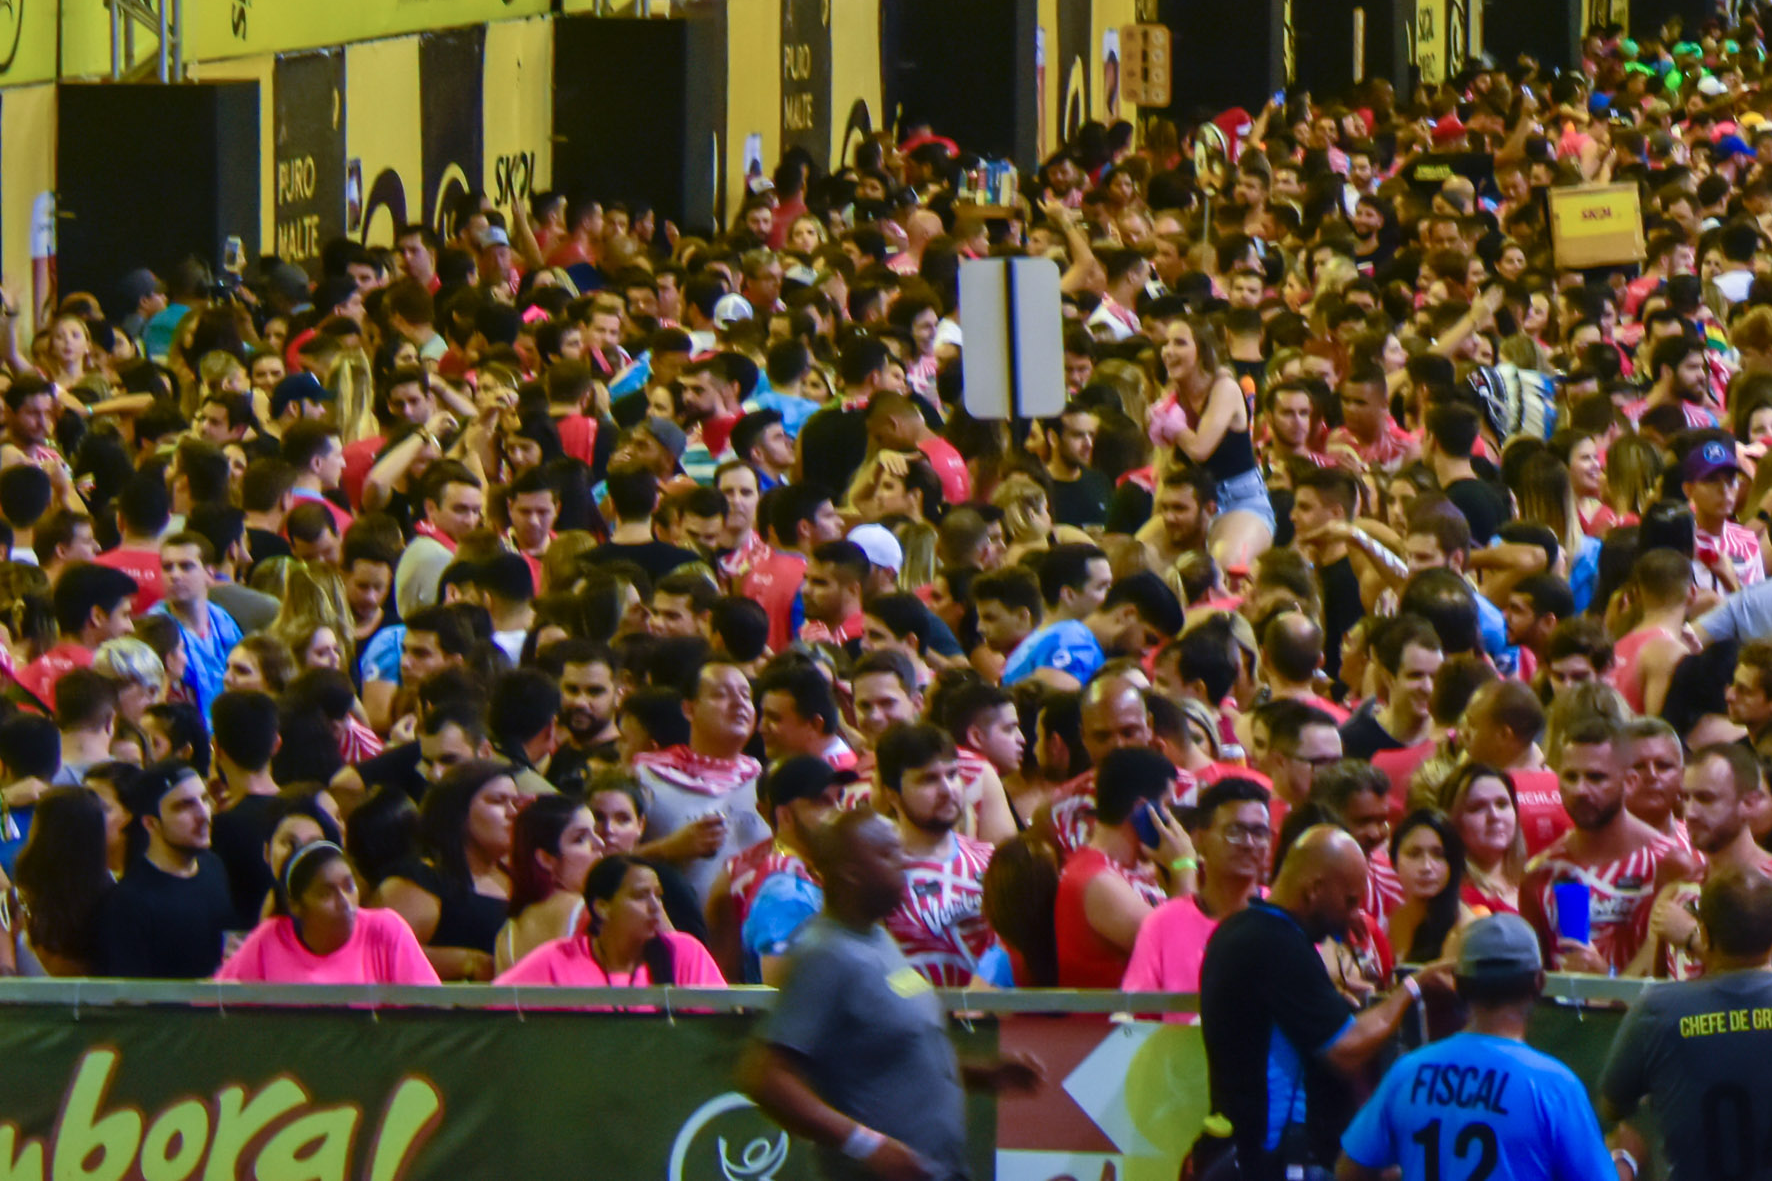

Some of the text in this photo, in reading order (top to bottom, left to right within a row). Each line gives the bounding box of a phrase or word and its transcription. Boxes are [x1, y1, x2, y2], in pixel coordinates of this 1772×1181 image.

[277, 154, 317, 207] PURO
[1679, 1011, 1727, 1039] CHEFE
[1728, 1008, 1750, 1032] DE
[1409, 1062, 1510, 1116] FISCAL
[1412, 1117, 1499, 1181] 12
